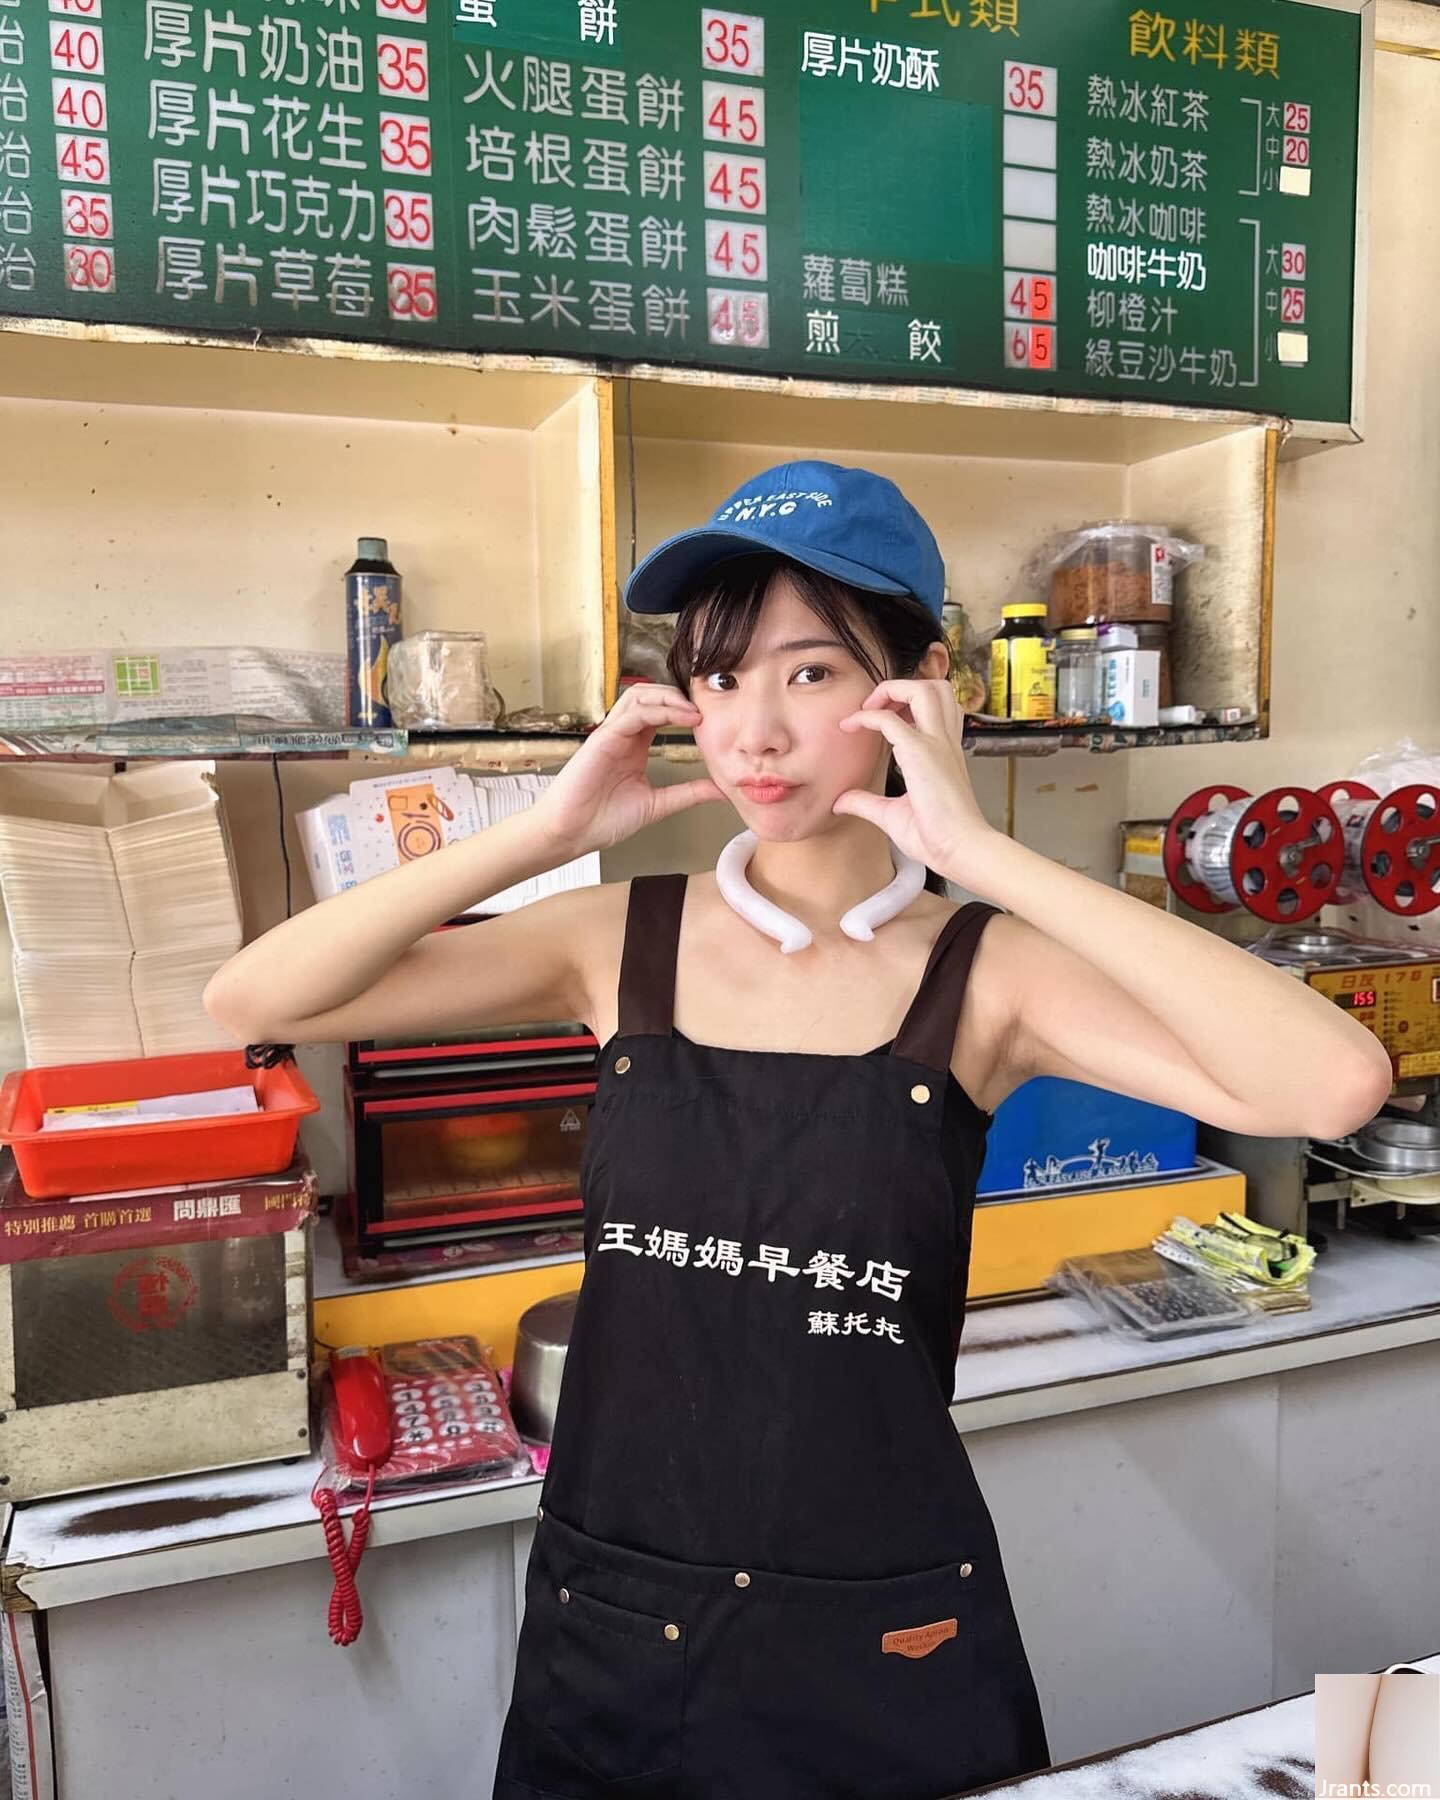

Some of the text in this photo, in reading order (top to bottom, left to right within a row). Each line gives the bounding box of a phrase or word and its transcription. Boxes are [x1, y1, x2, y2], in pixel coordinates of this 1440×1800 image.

[54, 29, 99, 70] 40
[144, 0, 364, 93] 厚片奶油
[706, 19, 750, 67] 35
[801, 31, 939, 92] 厚片奶酥
[1129, 9, 1280, 80] 飲料類
[378, 43, 427, 94] 35
[463, 50, 685, 132] 火腿蛋餅
[1008, 67, 1044, 111] 35
[57, 89, 102, 128] 40
[148, 79, 367, 170] 厚片花生
[708, 96, 757, 142] 45
[1087, 74, 1210, 132] 熱冰紅茶
[1265, 103, 1281, 129] 大
[1285, 107, 1309, 132] 25
[60, 139, 104, 180] 45
[380, 120, 431, 170] 35
[466, 124, 686, 202] 培根蛋餅
[1087, 136, 1208, 192] 熱冰奶茶
[1266, 136, 1280, 158] 中
[1286, 138, 1308, 163] 20
[153, 158, 375, 242] 厚片巧克力
[709, 163, 761, 210] 45
[66, 194, 110, 236] 35
[384, 196, 430, 241] 35
[468, 196, 688, 271] 肉鬆蛋餅
[1087, 193, 1208, 245] 熱冰咖啡
[69, 249, 111, 289] 30
[156, 236, 374, 317] 厚片草莓
[714, 231, 760, 276] 45
[1087, 242, 1206, 291] 咖啡牛奶
[1265, 248, 1279, 276] 大
[1282, 250, 1307, 275] 30
[388, 267, 437, 317] 35
[802, 253, 909, 307] 蘿蔔糕
[1010, 278, 1049, 314] 45
[471, 268, 690, 340] 玉米蛋餅
[1087, 289, 1178, 335] 柳橙汁
[1265, 291, 1278, 318] 中
[1281, 291, 1305, 321] 25
[806, 310, 942, 363] 煎 餃
[1013, 325, 1048, 361] 65
[1085, 338, 1238, 388] 綠豆沙牛奶
[173, 1194, 241, 1222] 問鼎匯
[598, 1222, 911, 1302] 王媽媽早餐店
[807, 1310, 905, 1344] 蘇托托
